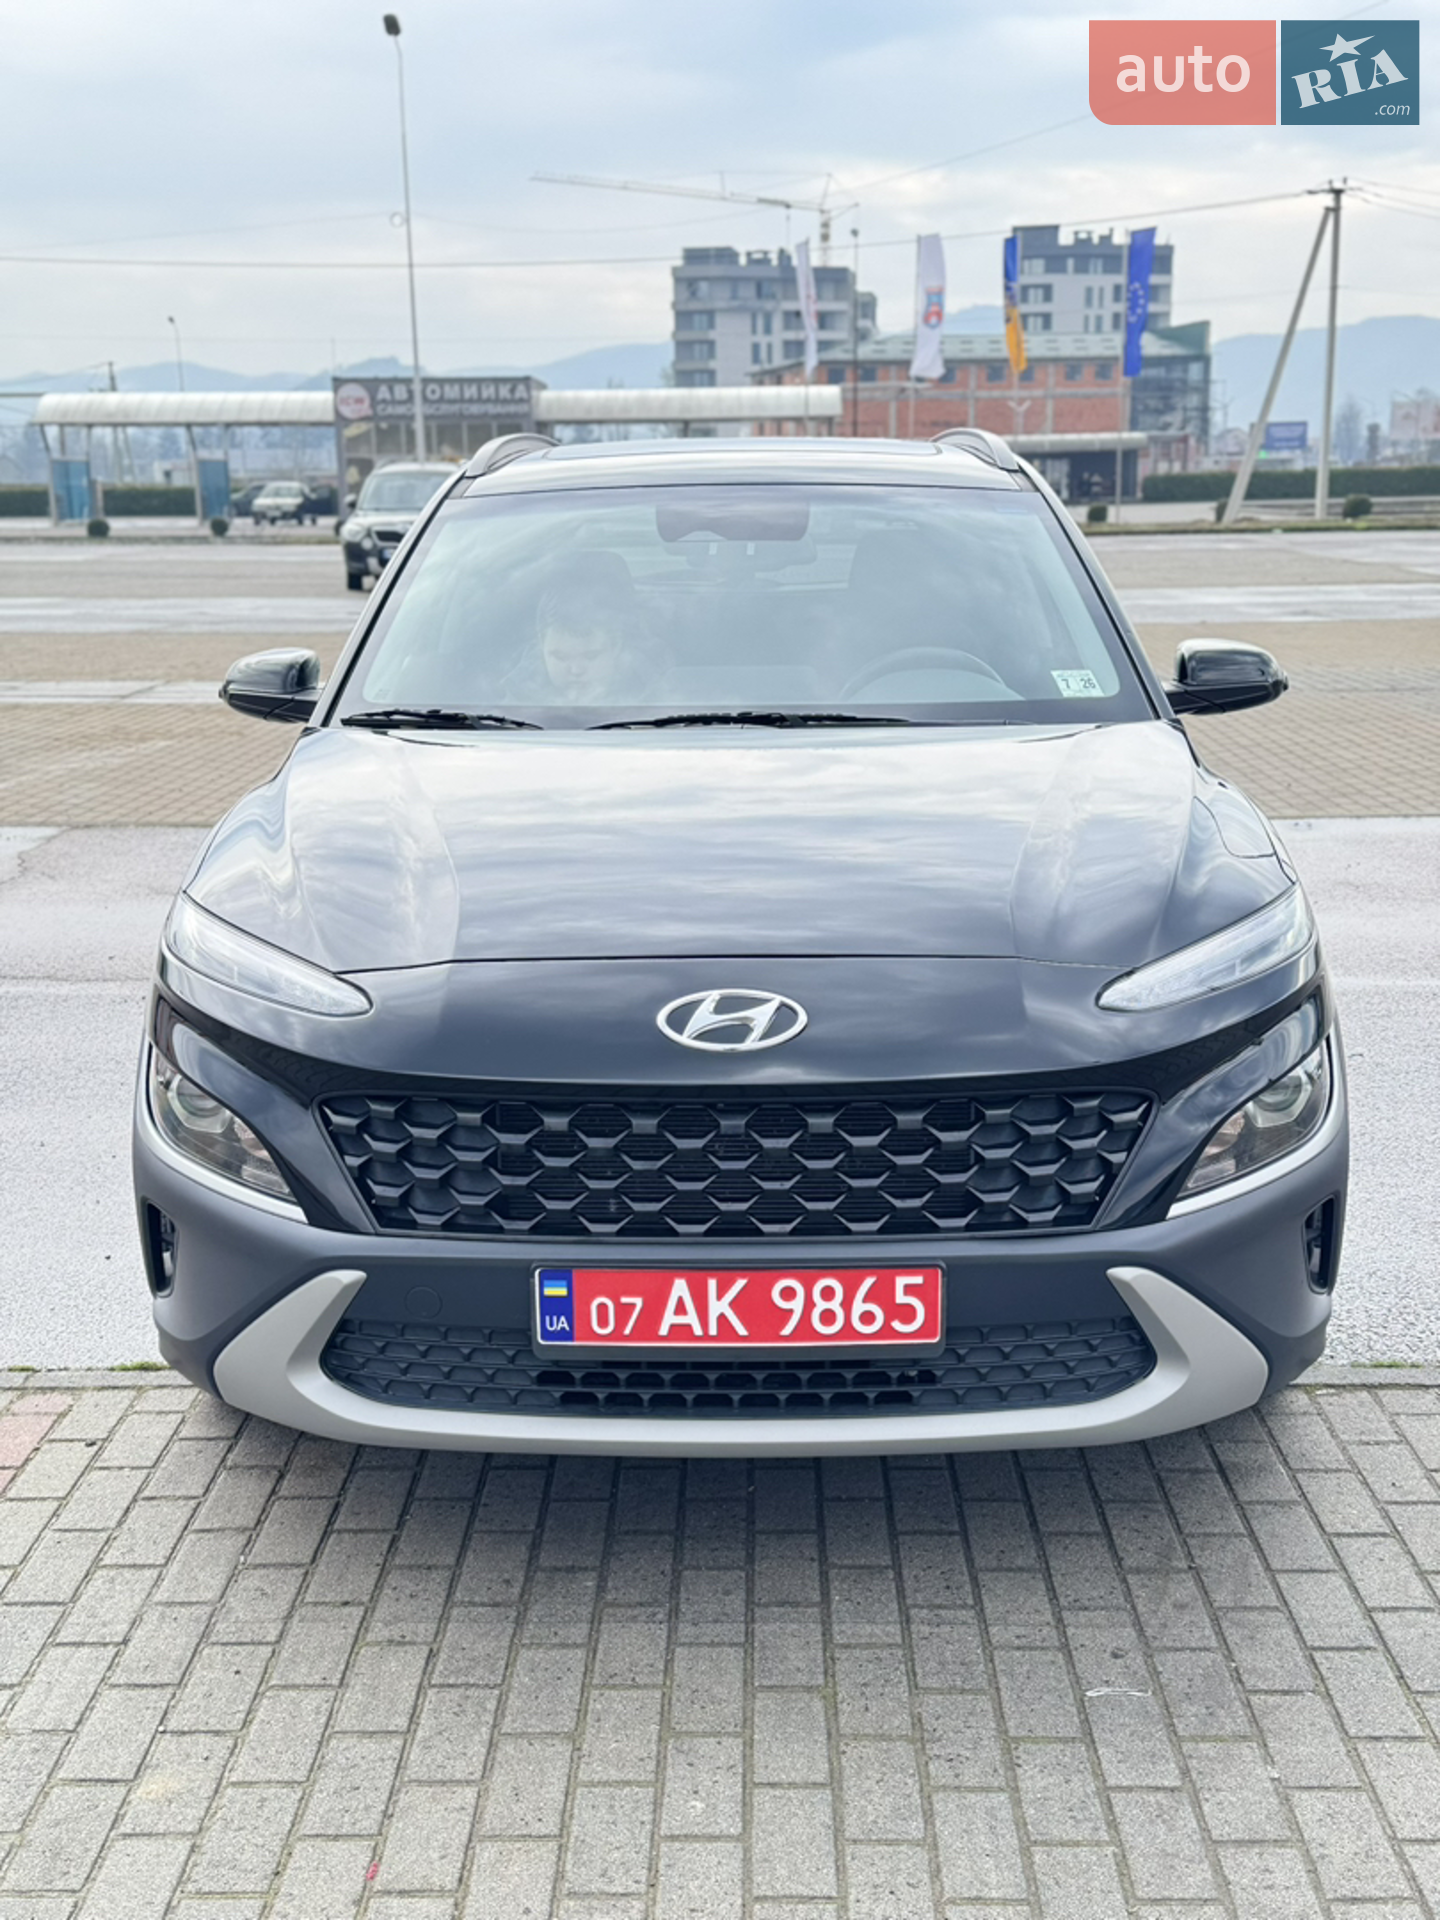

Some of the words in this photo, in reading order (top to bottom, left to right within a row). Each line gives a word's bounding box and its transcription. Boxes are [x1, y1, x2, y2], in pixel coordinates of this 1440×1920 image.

[545, 1315, 570, 1332] UA
[589, 1296, 643, 1336] 07
[658, 1277, 749, 1337] AK
[770, 1275, 926, 1336] 9865
